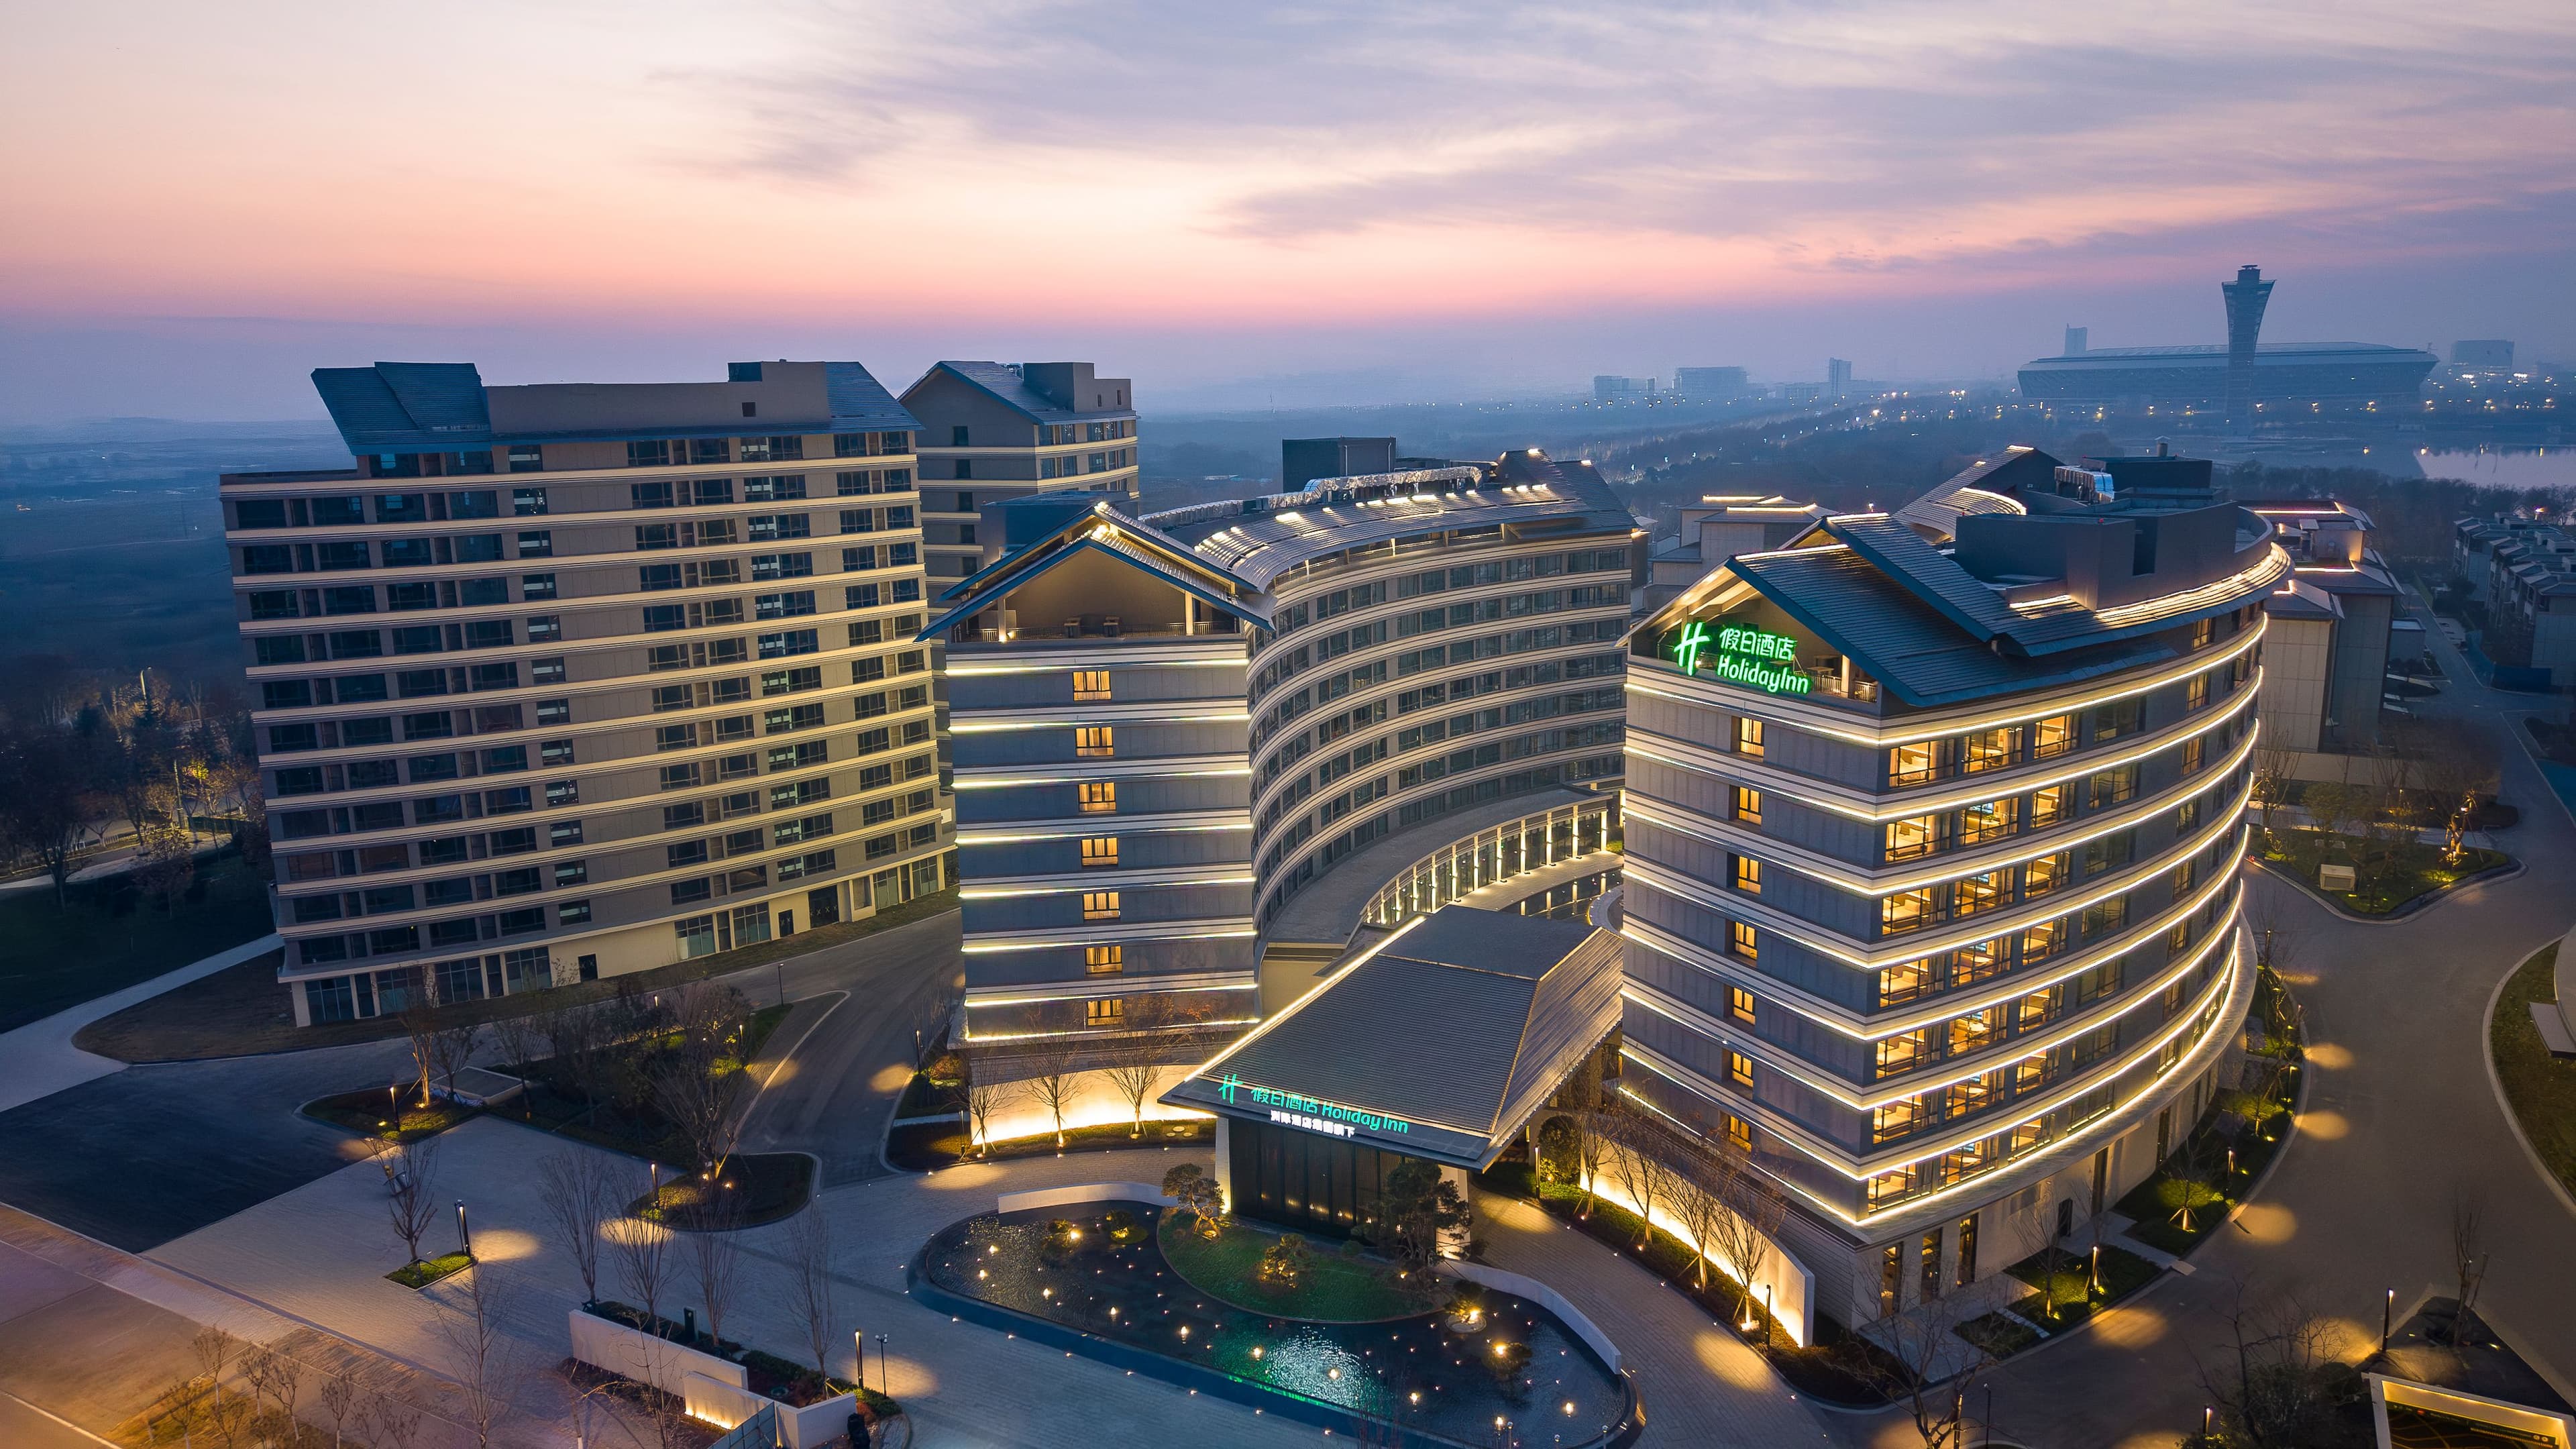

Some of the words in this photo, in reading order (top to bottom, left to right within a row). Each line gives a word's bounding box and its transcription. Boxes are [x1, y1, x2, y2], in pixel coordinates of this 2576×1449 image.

[1719, 627, 1798, 661] 假日酒店
[1251, 1087, 1318, 1114] 假日酒店
[1322, 1100, 1381, 1131] Holiday
[1383, 1112, 1408, 1134] Inn
